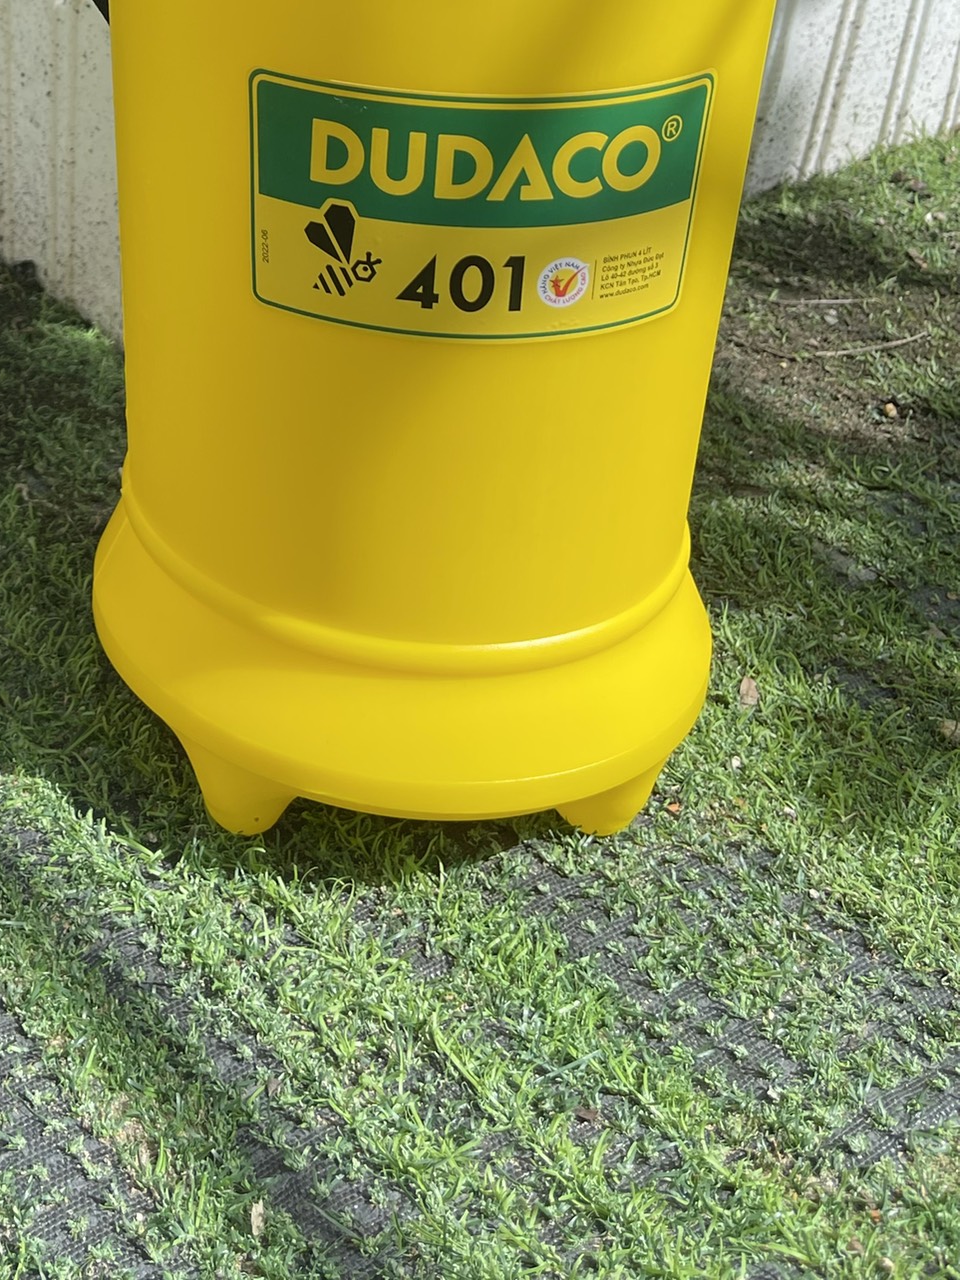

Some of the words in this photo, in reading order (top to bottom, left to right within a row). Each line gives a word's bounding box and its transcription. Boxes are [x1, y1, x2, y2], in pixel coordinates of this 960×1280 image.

[260, 229, 270, 263] 2022-06
[620, 251, 637, 260] PHUN
[395, 254, 526, 313] 401
[600, 282, 615, 290] KCN
